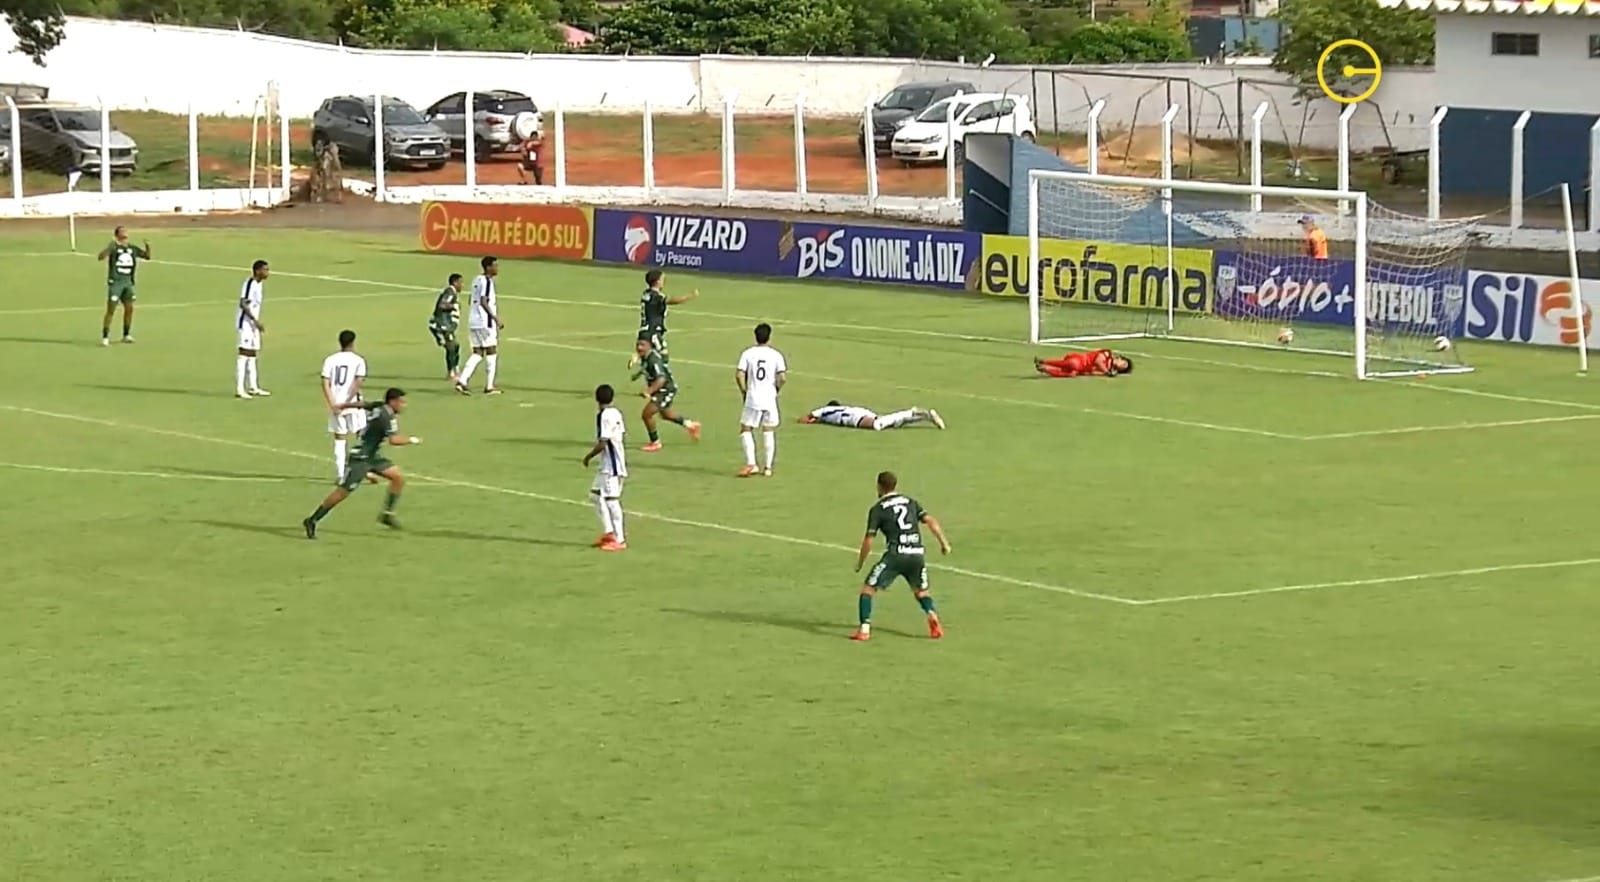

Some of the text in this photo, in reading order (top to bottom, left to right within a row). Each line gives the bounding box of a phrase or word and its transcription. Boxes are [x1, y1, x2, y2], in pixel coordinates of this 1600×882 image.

[450, 217, 583, 249] SANTA FÉ DO SUL
[655, 216, 747, 251] WIZARD
[655, 250, 702, 266] by Pearson
[852, 236, 863, 276] O
[865, 238, 911, 280] NOME
[913, 234, 935, 281] JÁ
[936, 242, 965, 283] DIZ
[985, 245, 1206, 311] eurofarma
[1364, 282, 1438, 324] UTEBOL
[334, 365, 348, 387] 10
[756, 359, 766, 381] 6
[893, 505, 912, 530] 2
